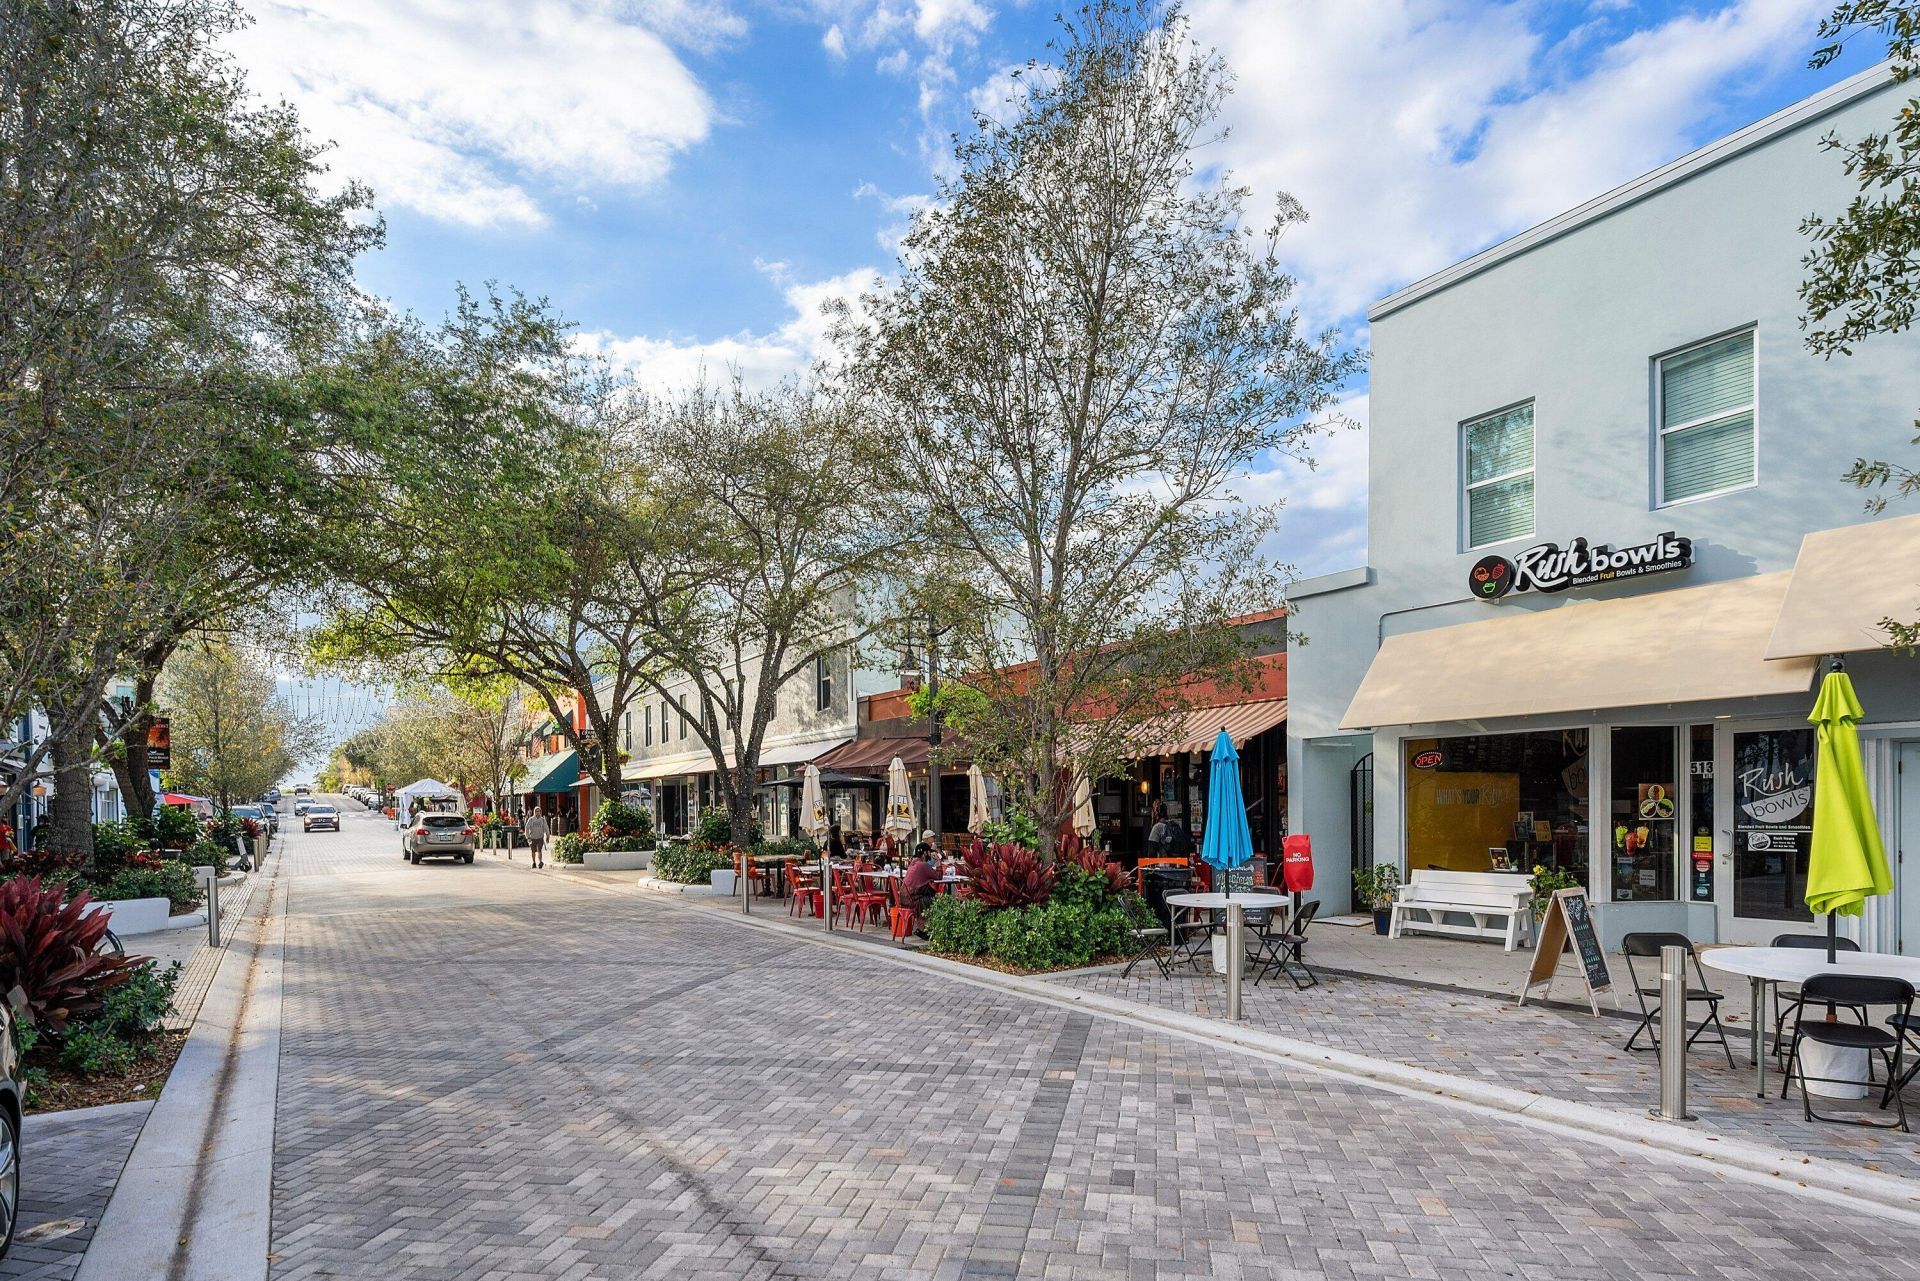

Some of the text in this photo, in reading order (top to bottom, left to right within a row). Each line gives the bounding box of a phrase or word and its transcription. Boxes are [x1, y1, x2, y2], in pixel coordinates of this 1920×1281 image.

[1514, 535, 1681, 588] Rush bowls
[1572, 560, 1682, 585] Blended Fruit Bowls & Smoothies
[1415, 753, 1442, 767] OPEN
[1690, 761, 1714, 774] 513
[1738, 762, 1804, 798] Rush
[1750, 791, 1808, 818] bowls
